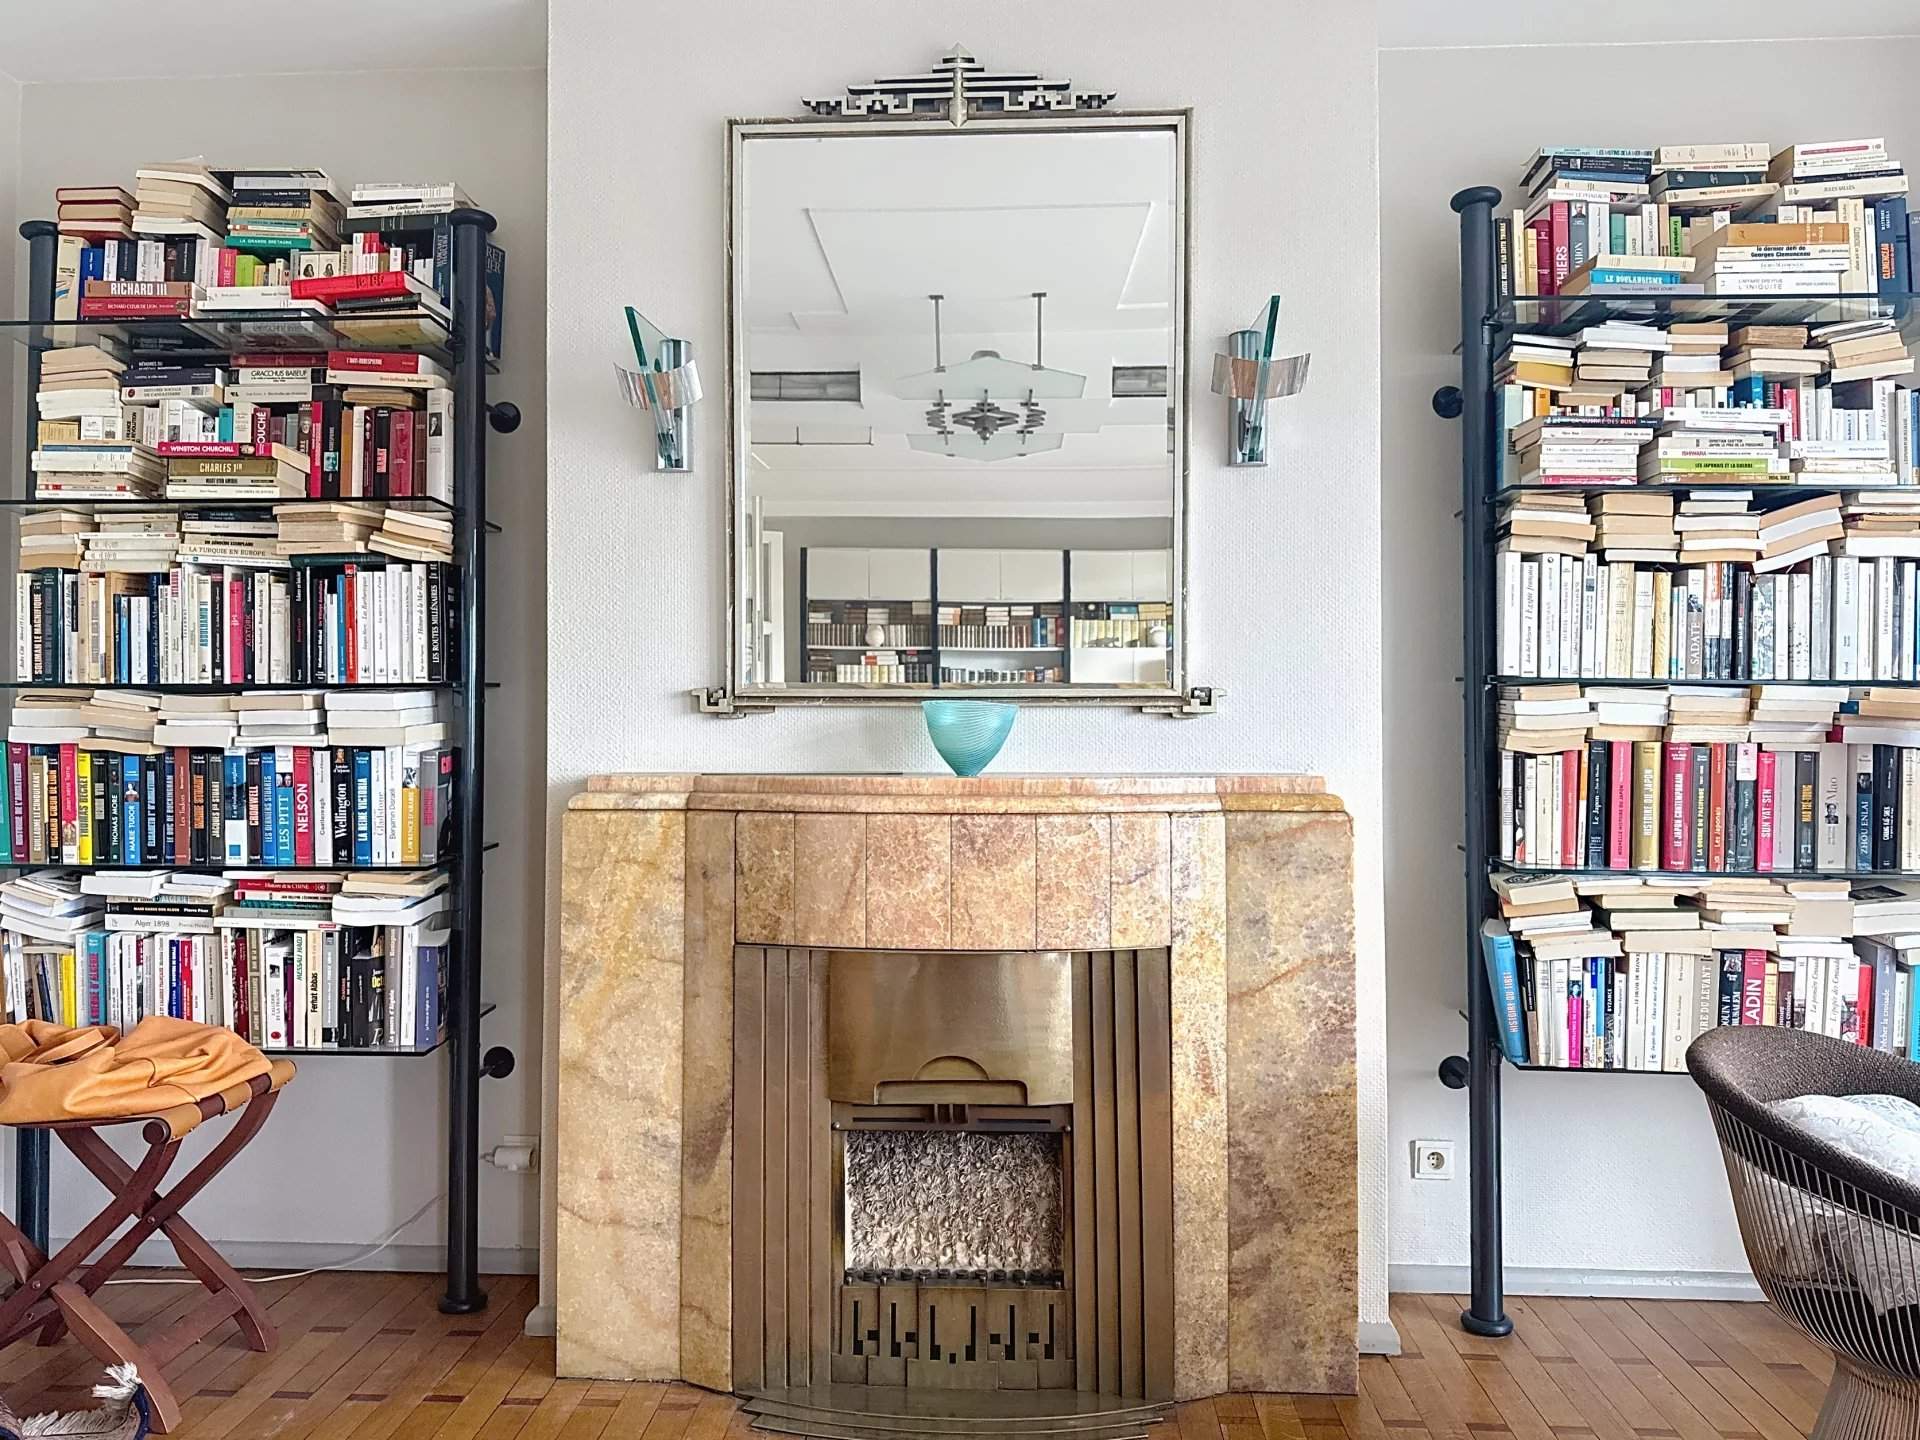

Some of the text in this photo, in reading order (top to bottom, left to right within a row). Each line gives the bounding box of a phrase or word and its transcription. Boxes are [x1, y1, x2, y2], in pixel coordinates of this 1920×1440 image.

[1556, 246, 1567, 286] THIERS
[1881, 243, 1890, 279] CLEMENCEAU
[111, 283, 167, 296] RICHARD III
[257, 412, 266, 443] OUCHÉ
[200, 463, 231, 472] CHARLES
[430, 585, 438, 625] MILLÉNAIRES
[1691, 623, 1700, 665] SADATE
[48, 770, 57, 784] LION
[50, 786, 57, 794] DE
[1825, 777, 1838, 799] Mao
[80, 776, 88, 837] THOMAS BECKET
[249, 785, 258, 825] CROMWELL
[297, 784, 308, 832] NELSON
[334, 783, 350, 839] Wellington
[358, 778, 367, 841] LA REINE VICTORIA
[1592, 795, 1602, 824] Le Japon
[1643, 768, 1653, 835] HISTOIRE DU JAPON
[1761, 788, 1772, 838] SUN YAT-SEN
[50, 818, 58, 847] RICHARD
[264, 833, 272, 842] LES
[279, 794, 289, 850] LES PITT
[1674, 819, 1682, 839] JAPON
[1861, 829, 1869, 854] ZHOU
[1503, 971, 1519, 1032] HISTOIRE DU TIBET
[1701, 965, 1711, 1012] DU LEVANT
[1881, 989, 1890, 1016] croisade
